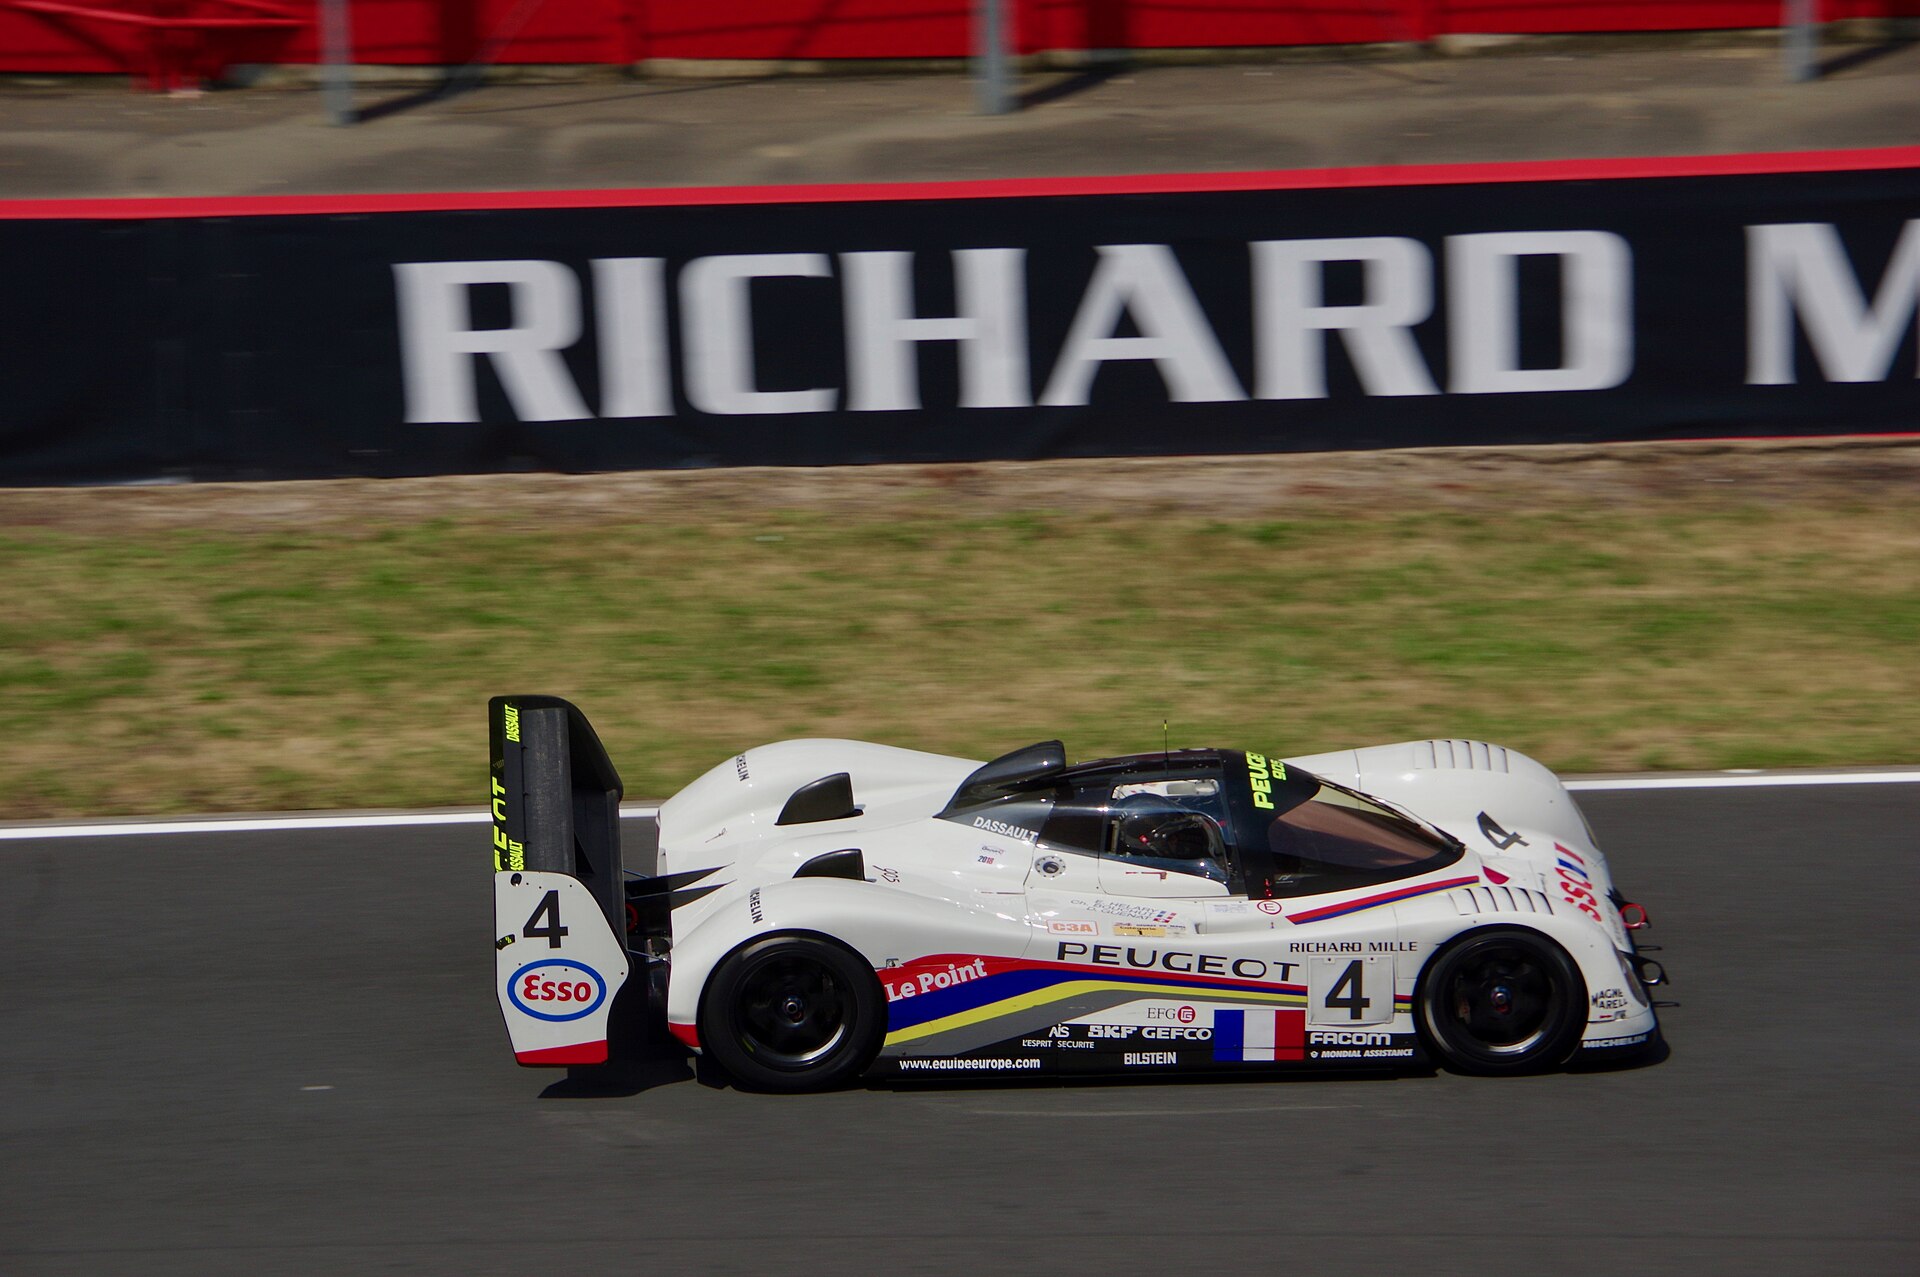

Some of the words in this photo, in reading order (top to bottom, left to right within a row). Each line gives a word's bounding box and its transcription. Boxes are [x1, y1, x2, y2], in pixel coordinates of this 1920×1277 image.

[393, 230, 1634, 425] RICHARD
[973, 816, 1040, 843] DASSAULT
[1477, 811, 1530, 850] 4
[522, 890, 569, 949] 4
[1053, 923, 1093, 933] C3A
[1290, 942, 1362, 953] RICHARD
[1368, 941, 1419, 952] MILLE
[1057, 941, 1300, 982] PEUGEOT
[884, 981, 915, 1002] Le
[916, 957, 988, 994] Point
[1324, 959, 1371, 1020] 4
[1147, 1007, 1176, 1019] EFG
[1087, 1025, 1138, 1039] SKF
[1141, 1027, 1212, 1041] GEFCO
[1310, 1032, 1391, 1046] FACOM
[1022, 1039, 1053, 1048] L'ESPRIT
[1124, 1051, 1177, 1065] BILSTEIN
[1321, 1050, 1362, 1058] MONDIAL
[1363, 1048, 1414, 1057] ASSISTANCE
